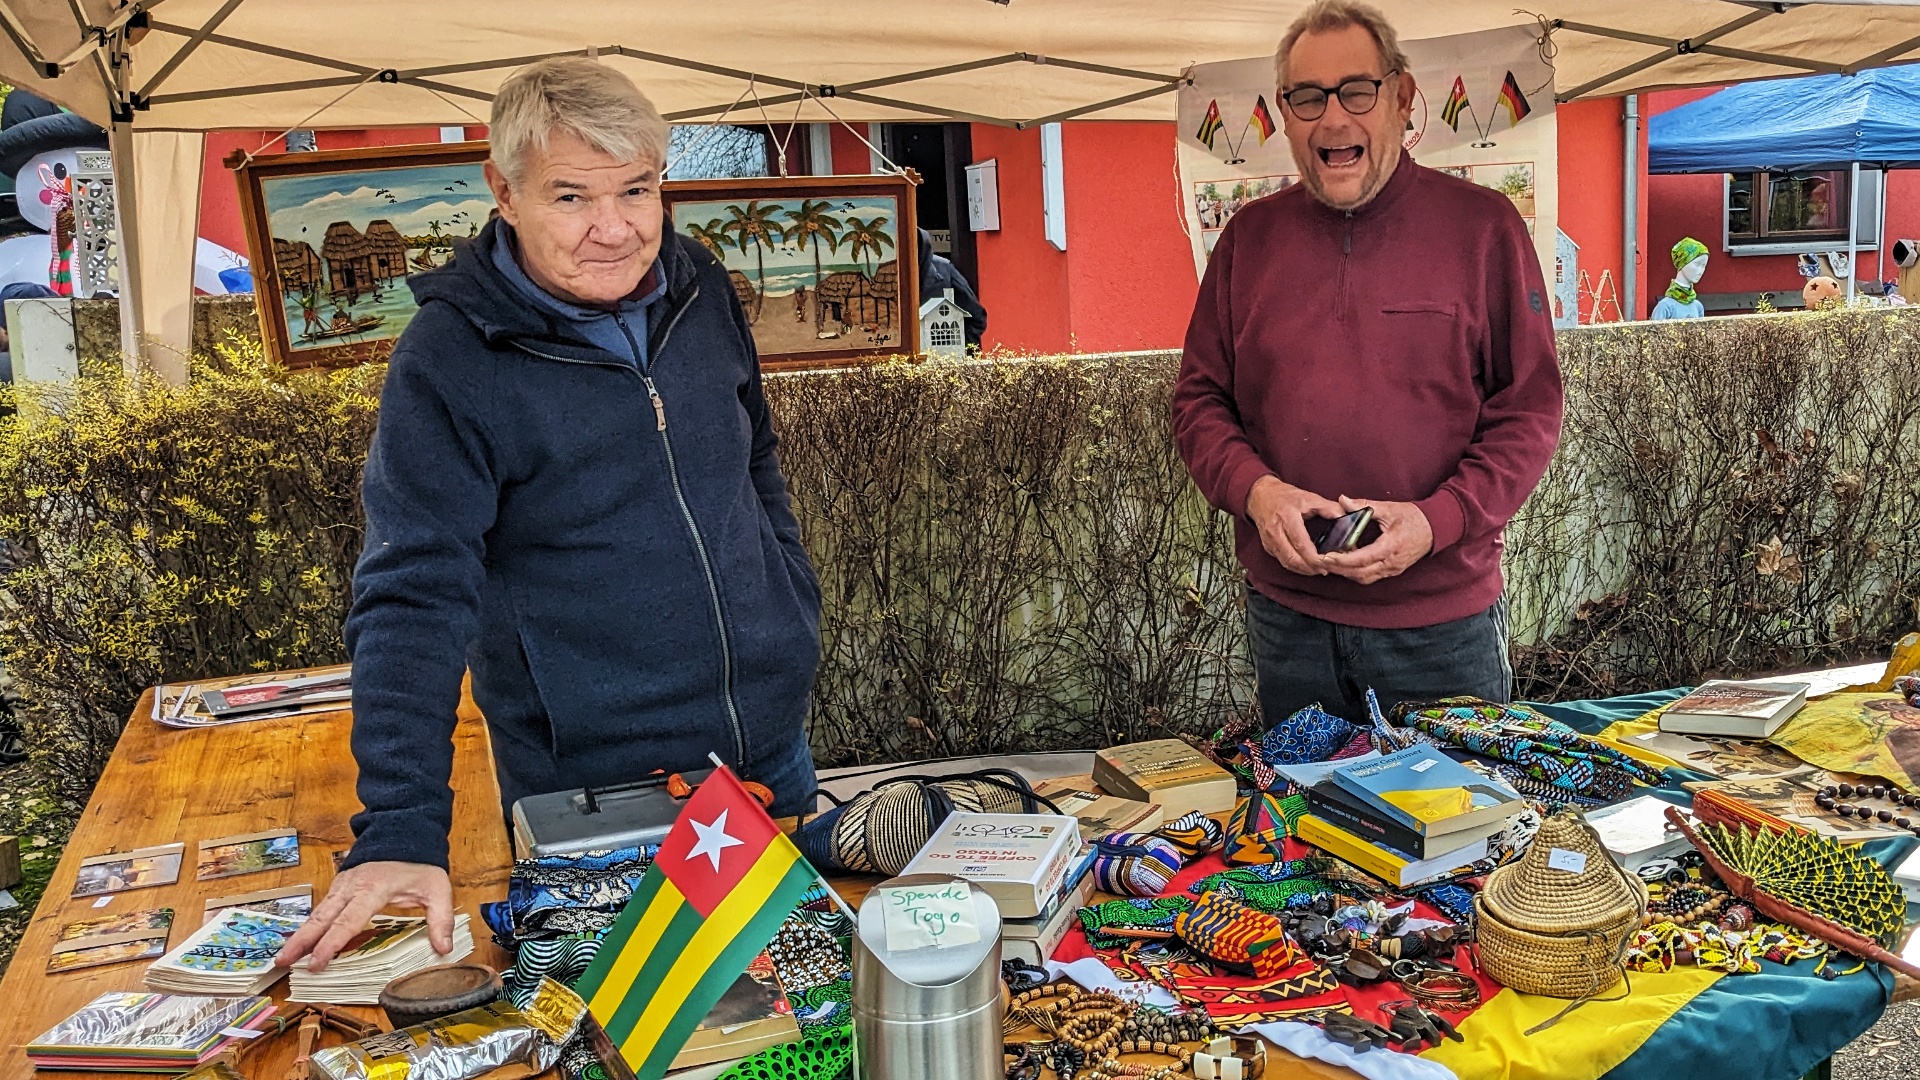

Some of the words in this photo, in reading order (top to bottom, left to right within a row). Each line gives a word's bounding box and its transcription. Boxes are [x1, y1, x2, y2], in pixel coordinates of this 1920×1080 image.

[933, 234, 944, 242] TV
[1347, 761, 1379, 773] Nadine
[1380, 749, 1422, 765] Gordimer
[1141, 762, 1202, 776] Wassermusik
[1078, 791, 1100, 800] PIPER
[928, 852, 952, 860] GO
[956, 848, 999, 856] TOGO
[1001, 849, 1018, 857] IN
[955, 853, 975, 861] TO
[980, 854, 1037, 862] COFFEE
[891, 887, 969, 906] Spende
[903, 907, 960, 936] Togo
